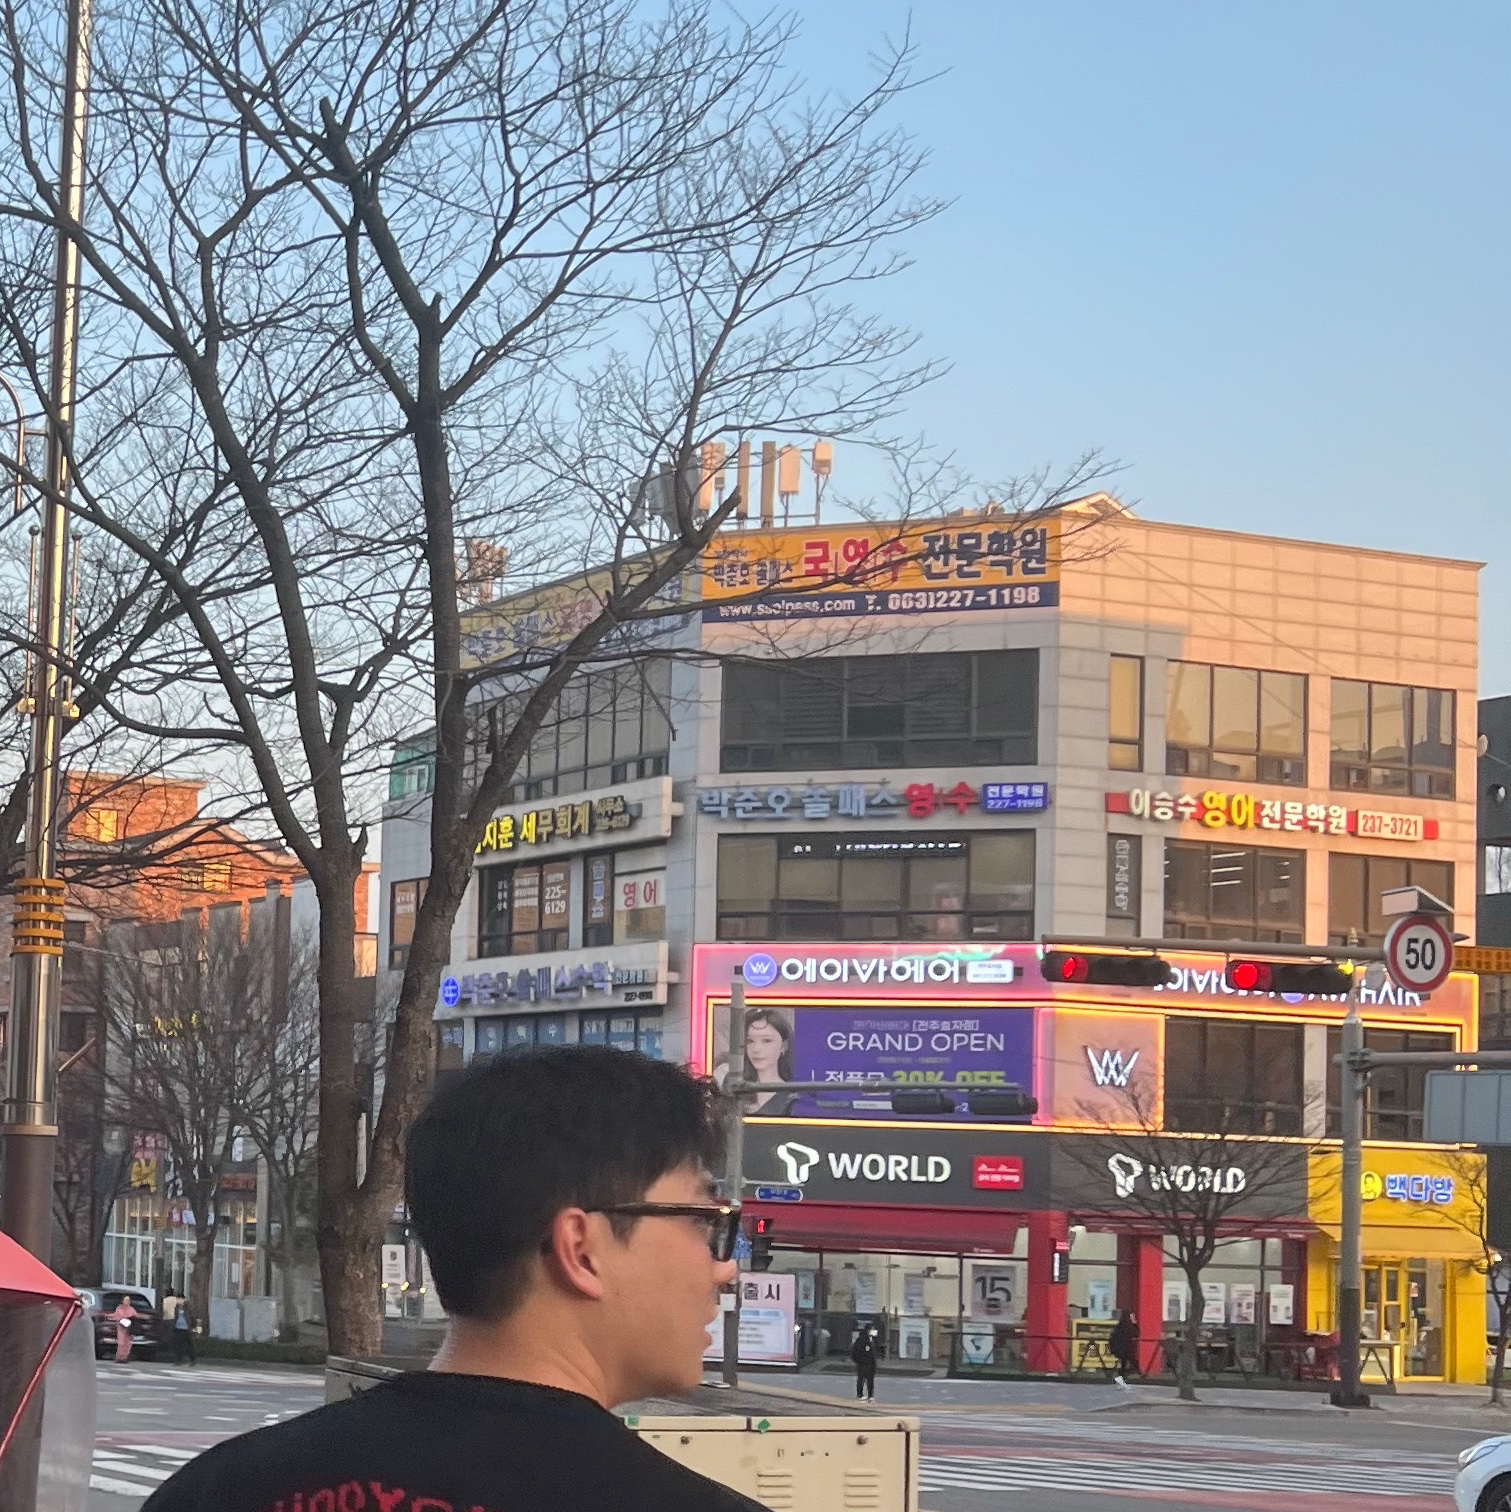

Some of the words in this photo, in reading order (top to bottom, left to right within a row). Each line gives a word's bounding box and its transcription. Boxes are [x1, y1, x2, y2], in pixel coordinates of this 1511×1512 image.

[923, 528, 1047, 580] 전문학원
[474, 816, 514, 854] 지훈
[520, 800, 592, 845] 세무회계
[1129, 788, 1197, 820] 이승수
[1203, 790, 1255, 829] 영어
[1260, 799, 1348, 835] 전문학원
[1362, 814, 1418, 837] 237-3721
[623, 880, 657, 908] 영어
[1406, 938, 1436, 970] 50
[781, 956, 960, 984] 에이바헤어
[826, 1032, 923, 1052] GRAND
[931, 1032, 1005, 1052] OPEN
[827, 1152, 952, 1183] WORLD
[1148, 1164, 1246, 1193] WORLD
[1385, 1174, 1455, 1203] 백다방
